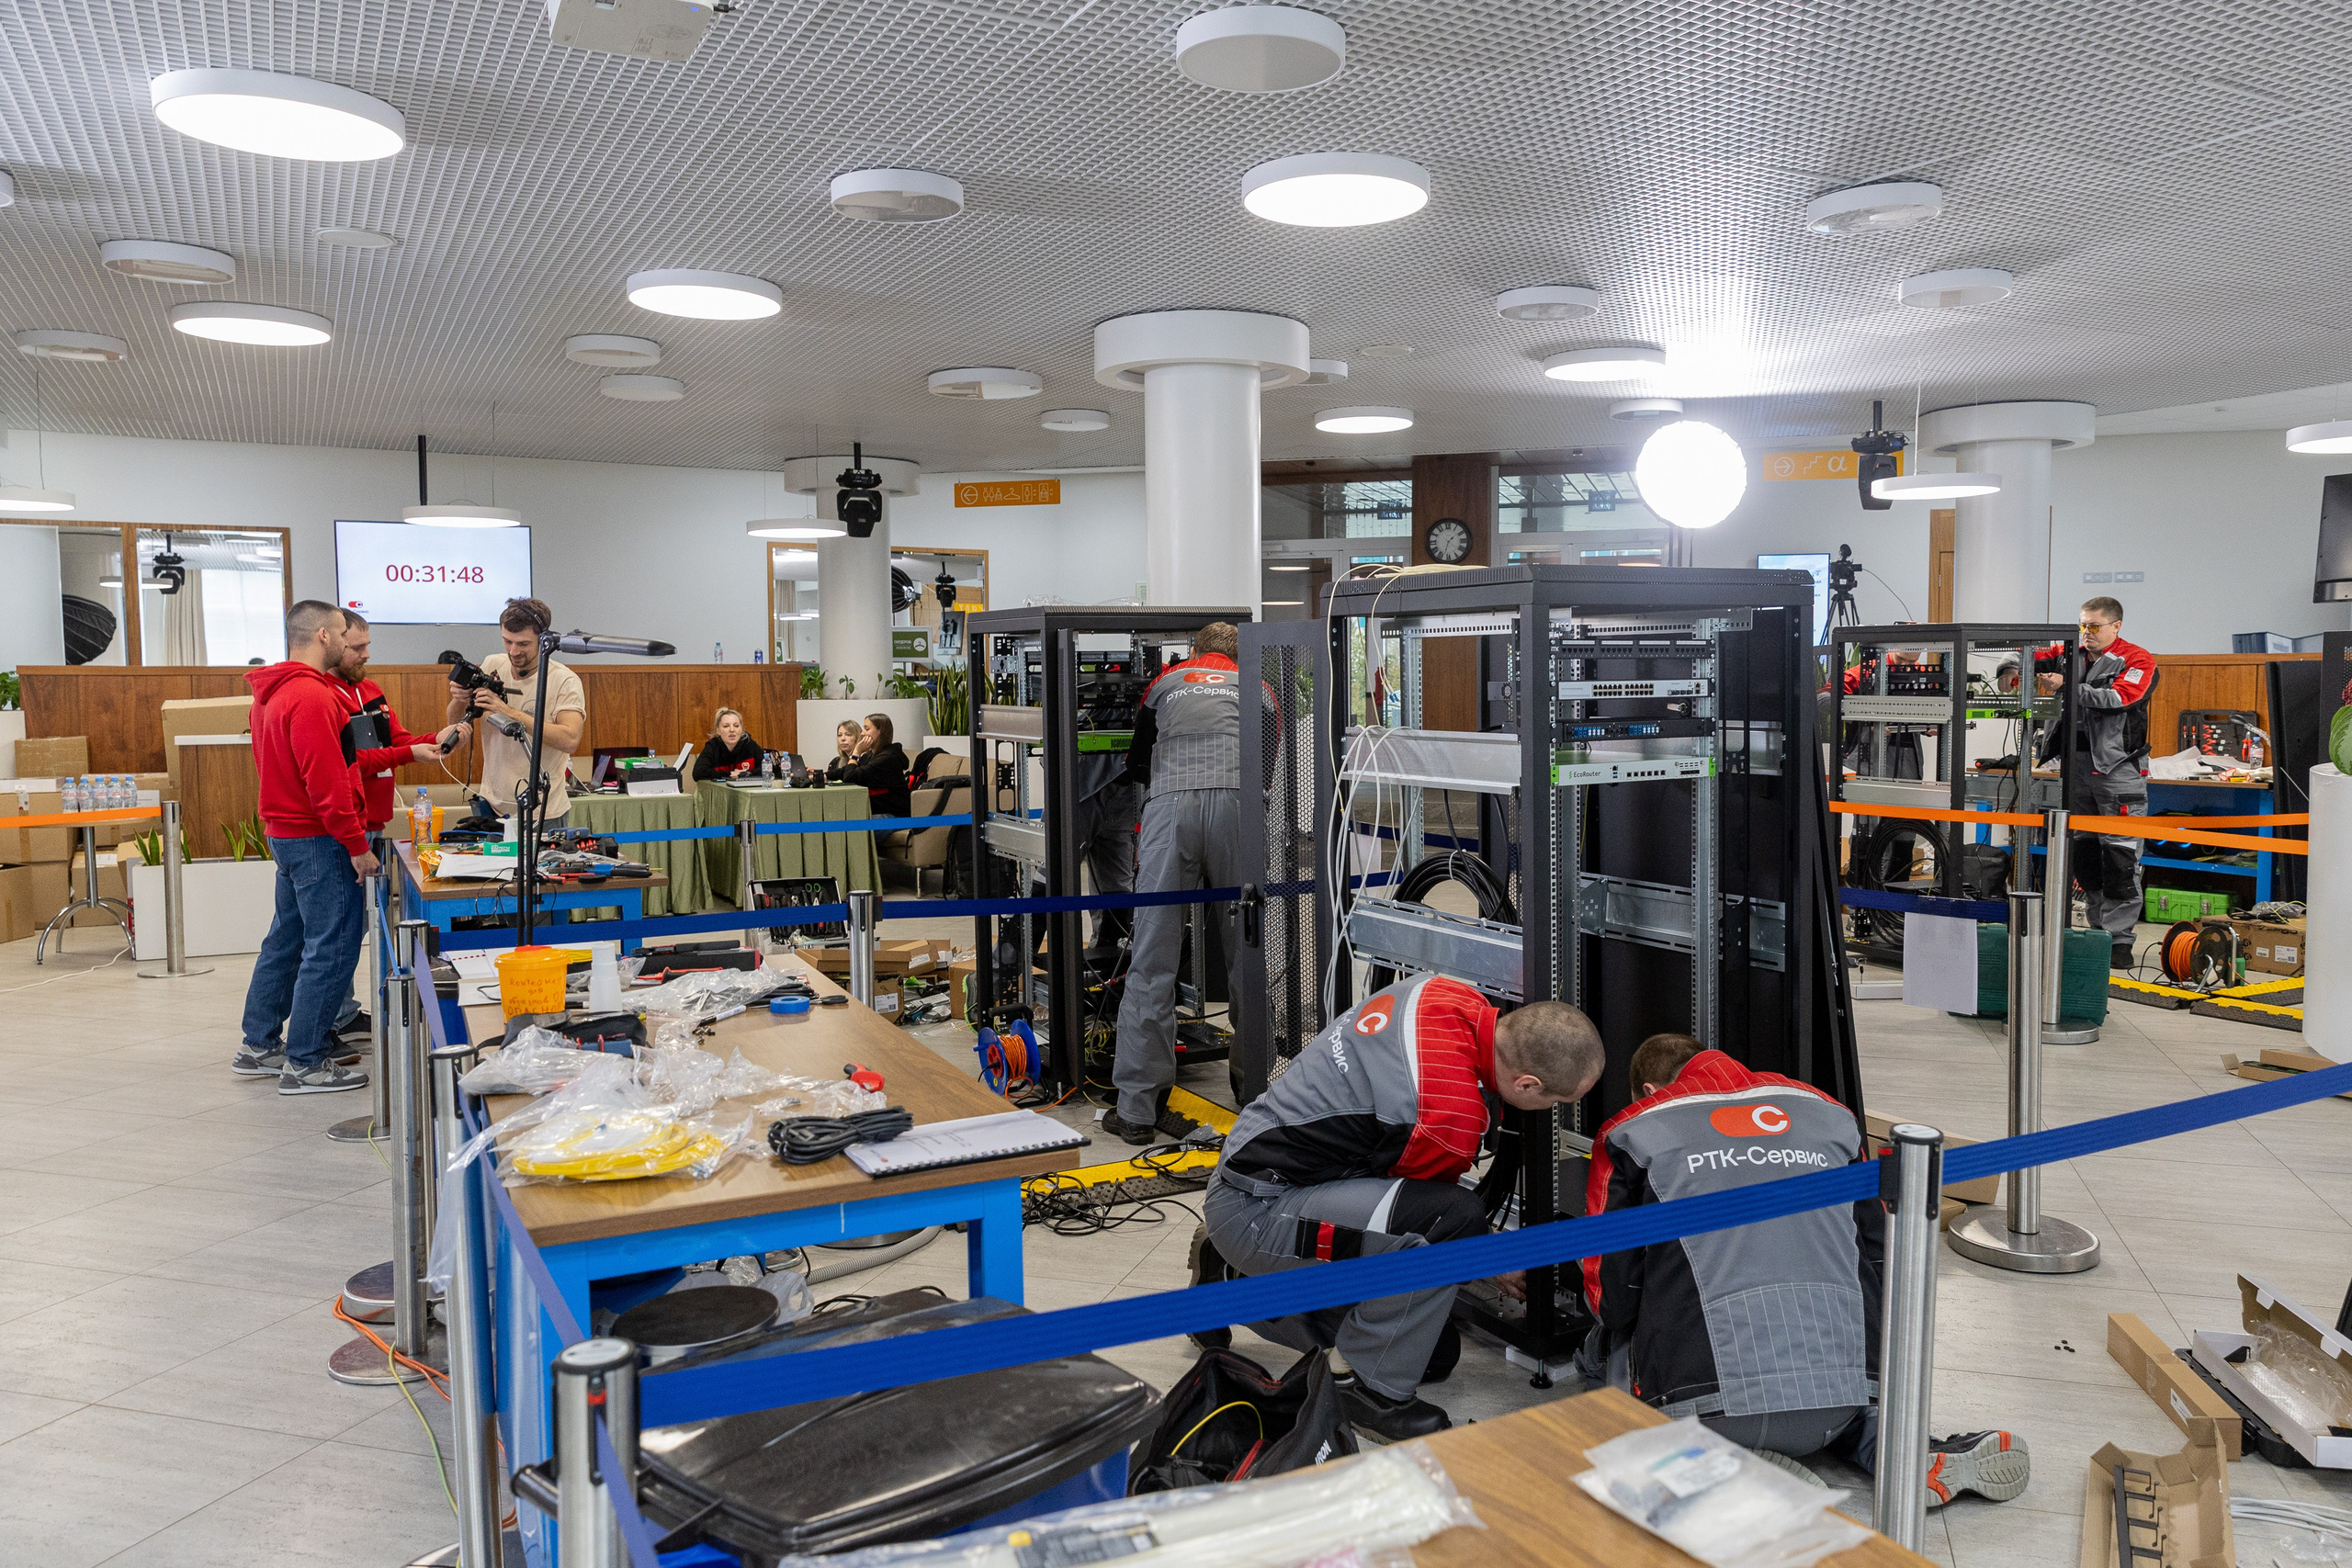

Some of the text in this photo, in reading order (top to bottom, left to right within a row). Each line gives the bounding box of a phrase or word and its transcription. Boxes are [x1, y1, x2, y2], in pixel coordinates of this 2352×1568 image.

[386, 564, 484, 583] 00:31:48
[1166, 685, 1239, 704] РТК-Сервис
[1573, 770, 1601, 779] EcoRouter
[1687, 1145, 1828, 1174] РТК-Сервис
